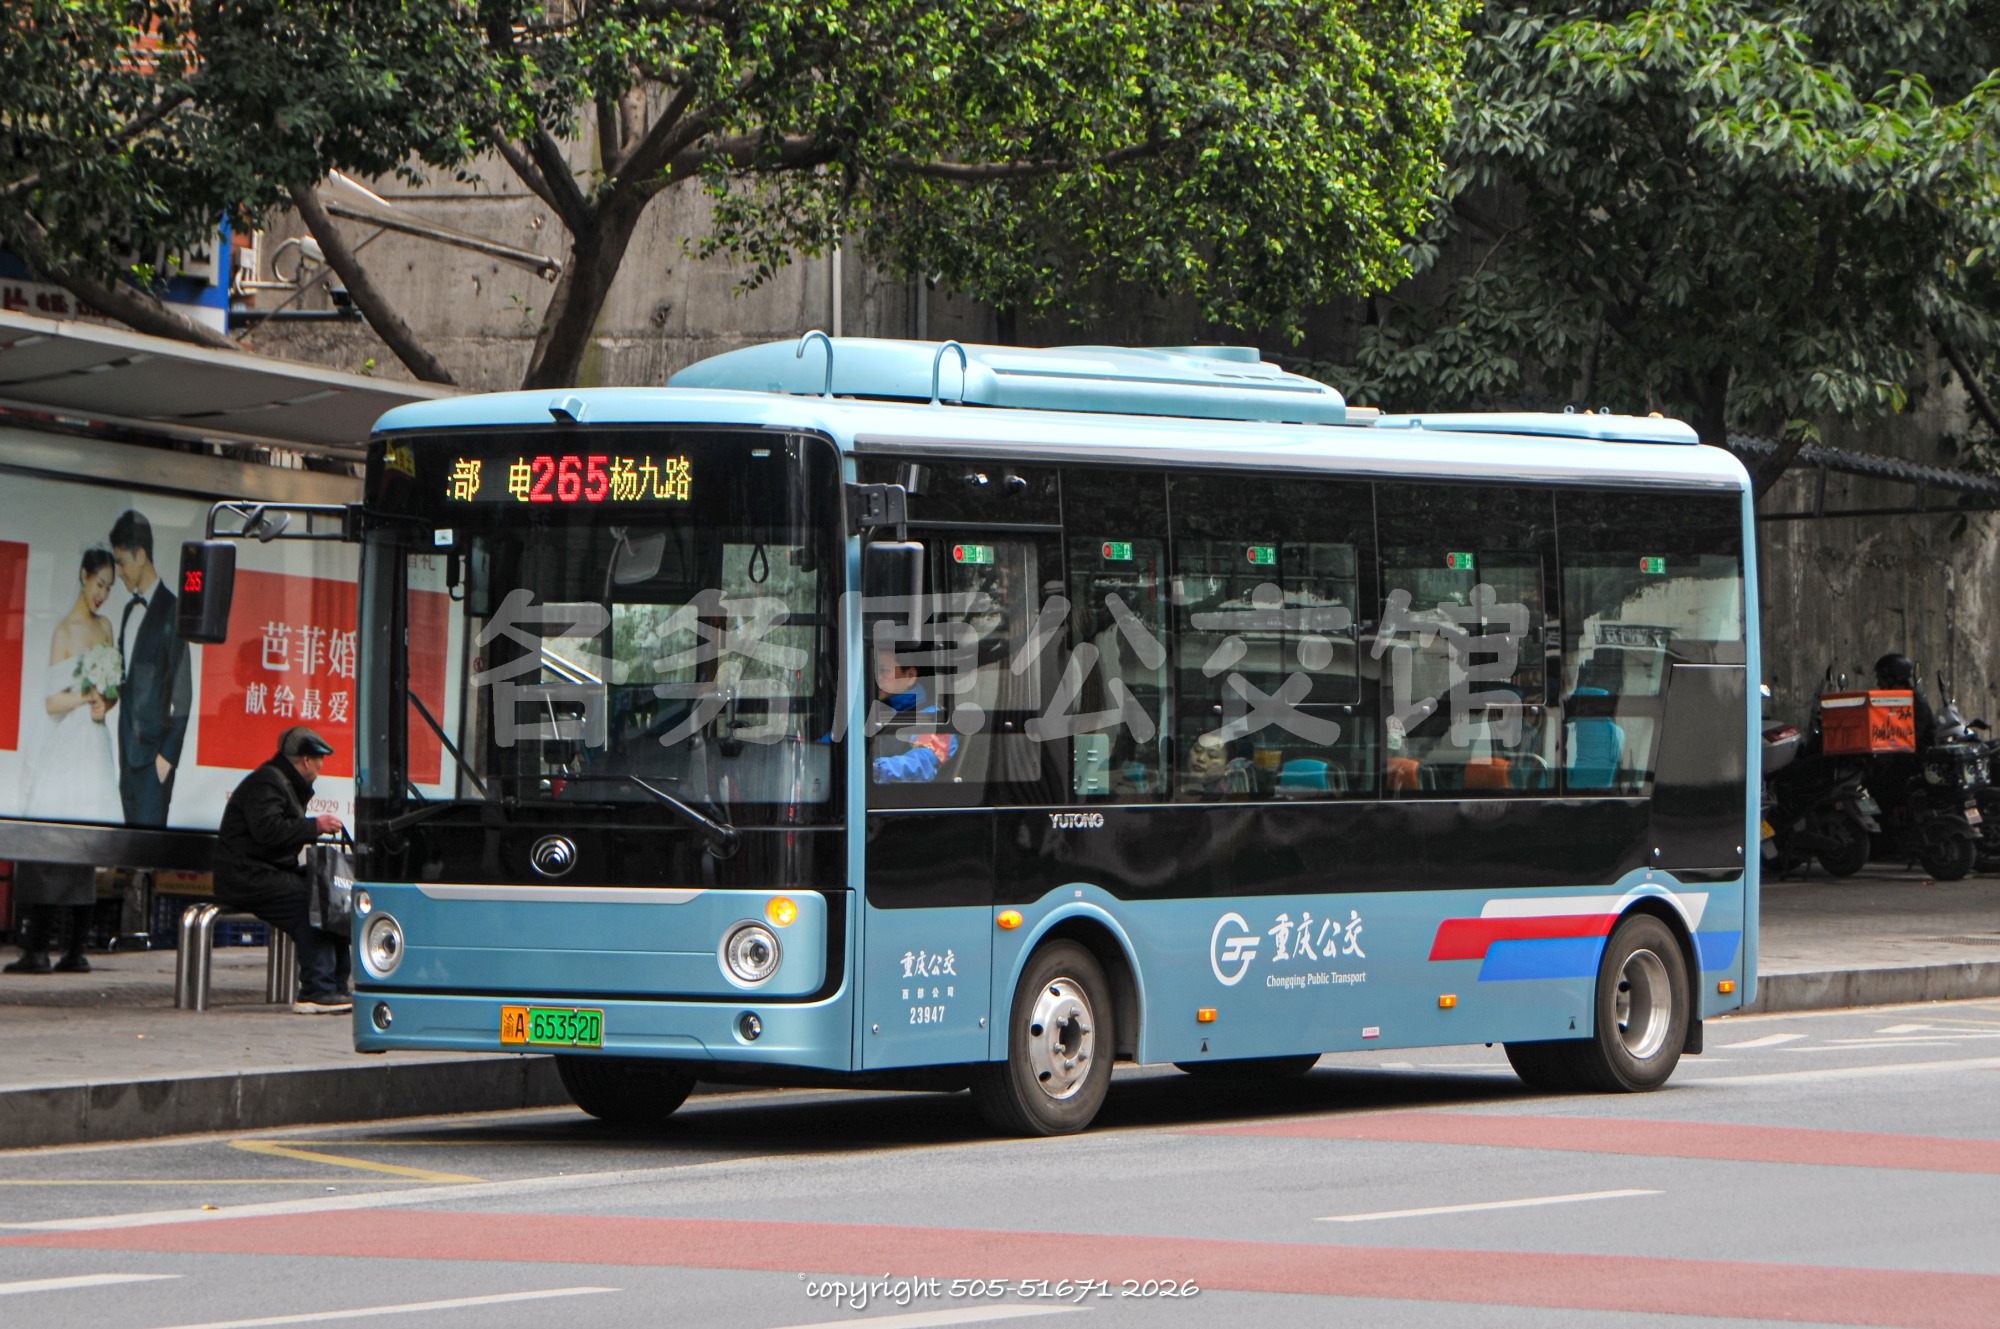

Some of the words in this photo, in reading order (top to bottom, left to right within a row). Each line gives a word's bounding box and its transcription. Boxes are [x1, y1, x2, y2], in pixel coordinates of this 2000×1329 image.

[530, 456, 611, 502] 265
[609, 455, 692, 501] 杨九路
[184, 571, 203, 592] 265
[260, 621, 357, 679] 芭菲婚
[245, 682, 349, 723] 献给最爱
[1049, 813, 1105, 829] YUTONG
[1267, 909, 1366, 962] 重庆公交
[900, 949, 957, 978] 重庆公交
[1266, 974, 1306, 989] Chongqing
[1307, 972, 1329, 985] Public
[1331, 971, 1367, 985] Transport
[909, 1005, 945, 1024] 23947
